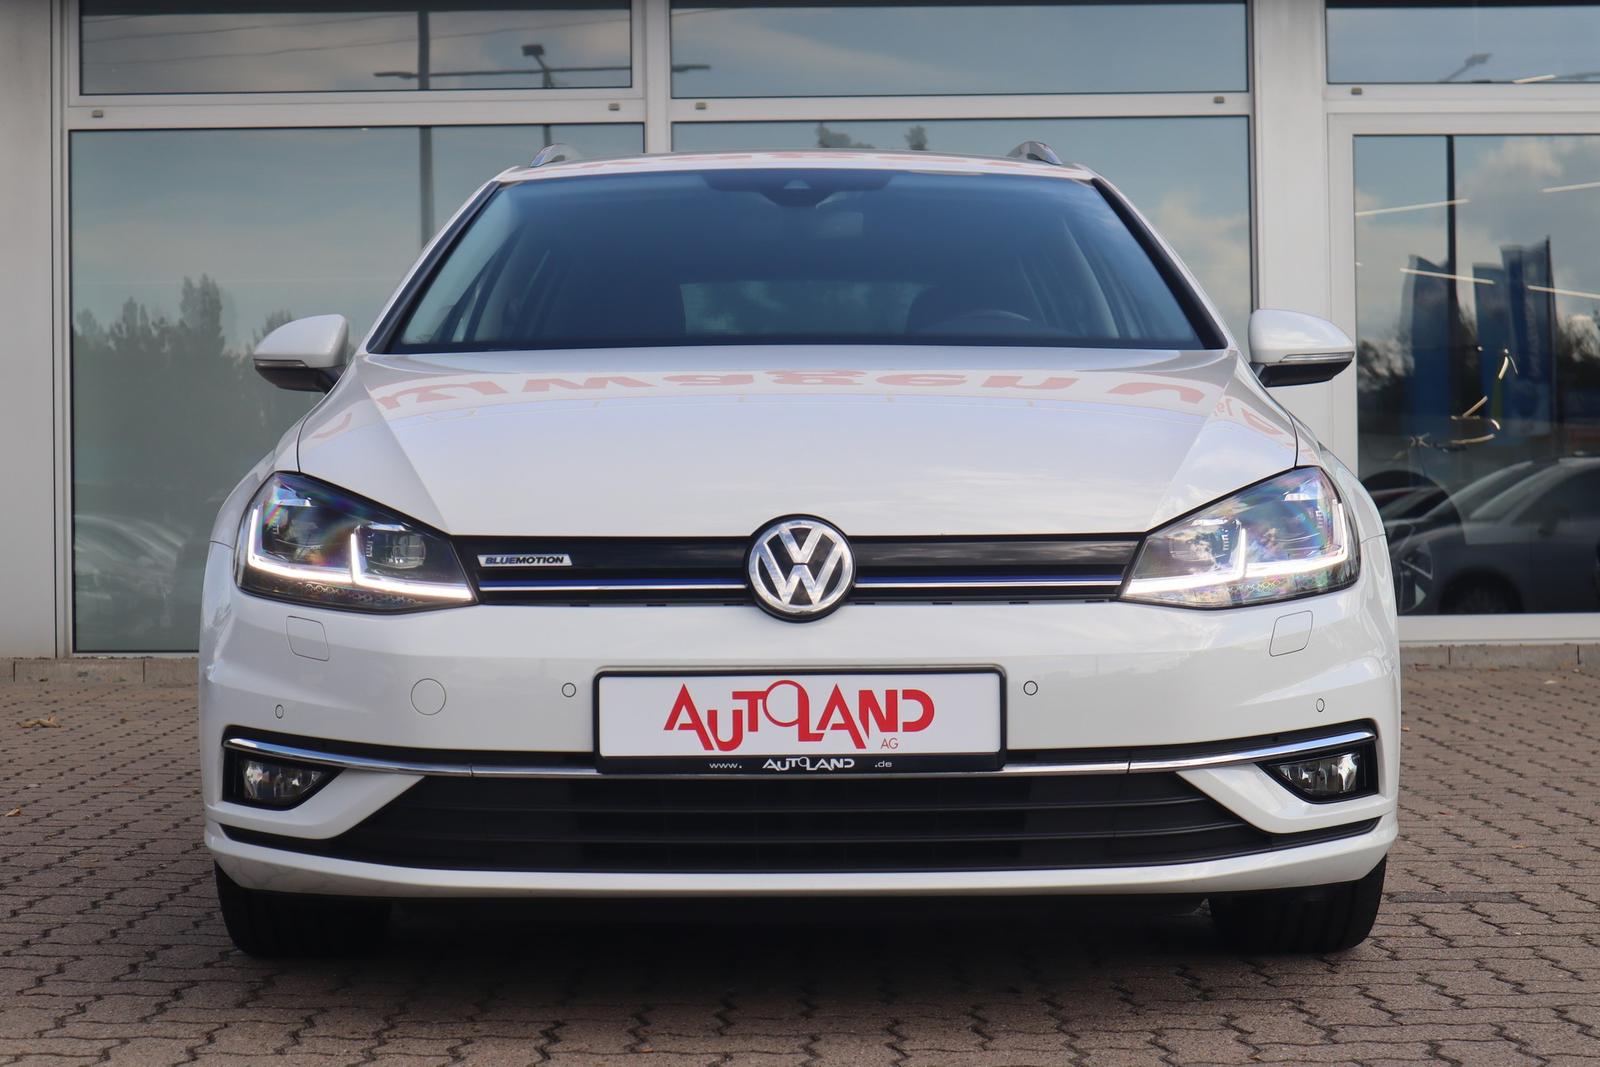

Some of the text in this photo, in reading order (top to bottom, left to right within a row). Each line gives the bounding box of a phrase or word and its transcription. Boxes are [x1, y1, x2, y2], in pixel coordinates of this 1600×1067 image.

[484, 555, 565, 566] BLUEMOTION
[663, 679, 936, 752] AUTOLAND
[880, 736, 899, 750] AG
[708, 762, 743, 770] www.
[761, 755, 856, 771] AUTOLAND
